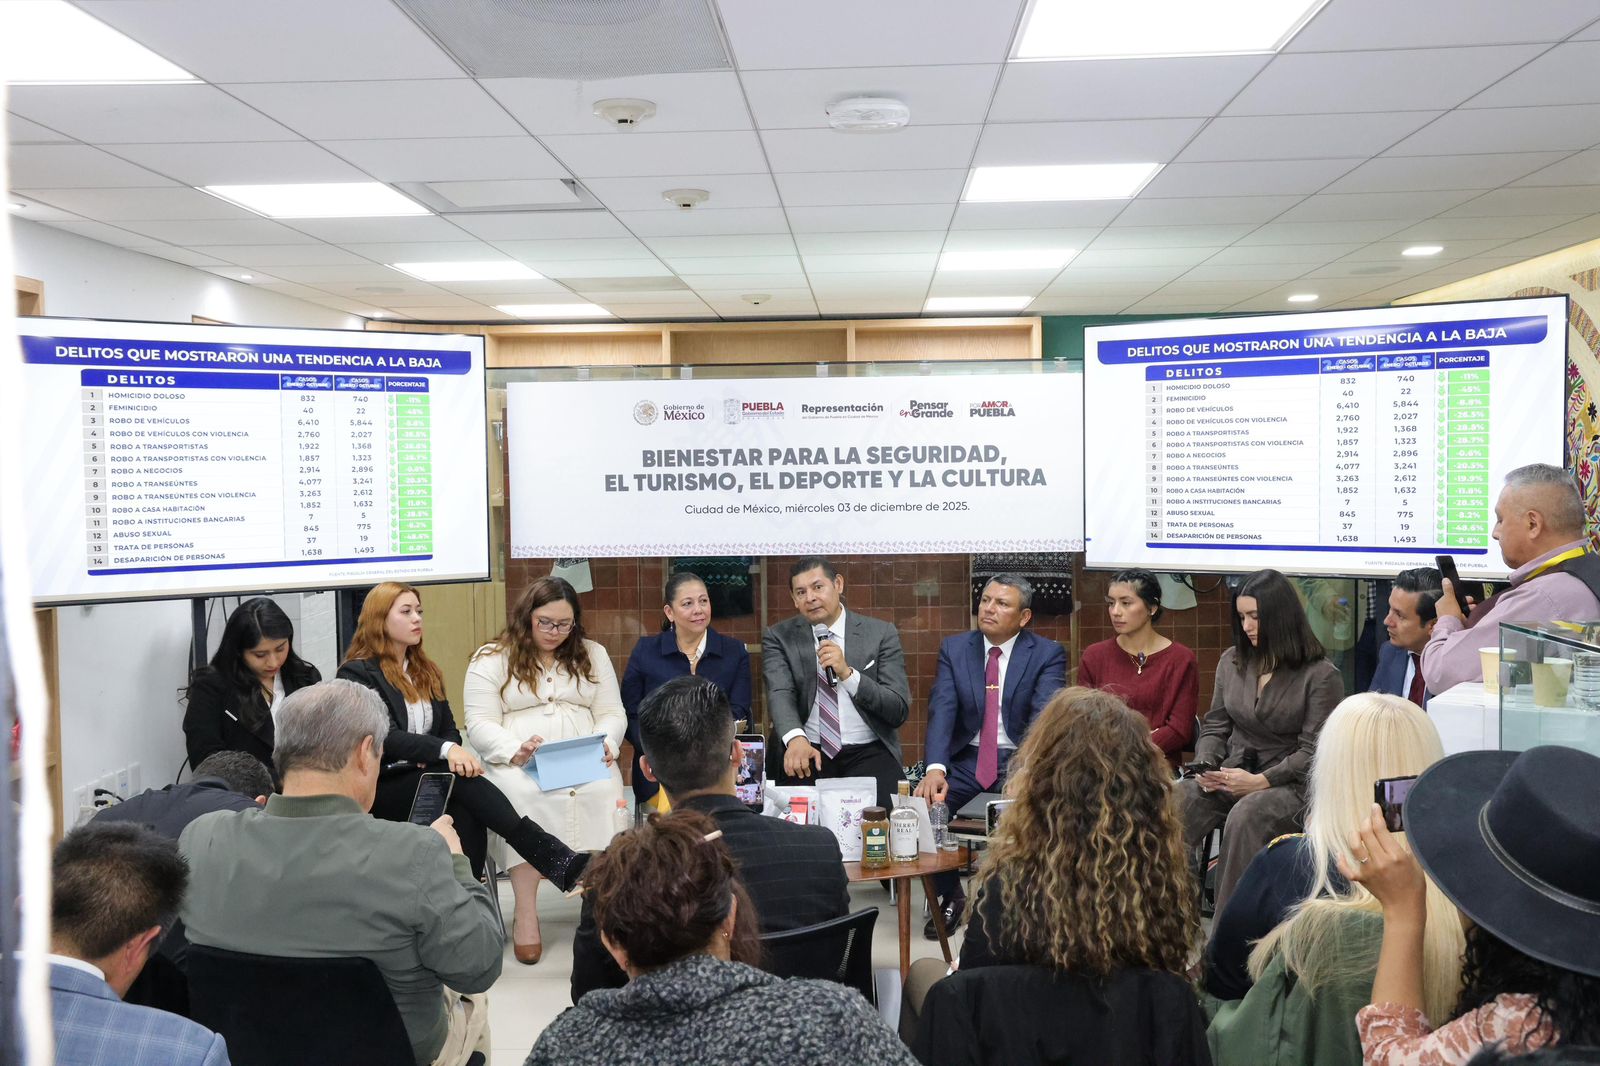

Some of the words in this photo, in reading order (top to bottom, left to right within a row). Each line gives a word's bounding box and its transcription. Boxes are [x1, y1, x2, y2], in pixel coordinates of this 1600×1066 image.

[1128, 345, 1179, 357] DELITOS
[1183, 344, 1209, 356] QUE
[1214, 339, 1299, 353] MOSTRARON
[1304, 338, 1334, 348] UNA
[1337, 331, 1422, 346] TENDENCIA
[1426, 331, 1437, 342] A
[1442, 330, 1461, 341] LA
[1465, 327, 1507, 340] BAJA
[55, 346, 123, 359] DELITOS
[127, 348, 160, 362] QUE
[165, 350, 259, 363] MOSTRARON
[263, 353, 293, 364] UNA
[297, 354, 373, 366] TENDENCIA
[376, 356, 386, 366] A
[390, 357, 406, 367] LA
[409, 357, 442, 368] BAJA
[1166, 367, 1223, 378] DELITOS
[107, 374, 176, 385] DELITOS
[1202, 382, 1231, 390] DOLOSO
[1400, 387, 1412, 395] 22
[300, 394, 316, 402] 832
[352, 395, 369, 403] 740
[1166, 394, 1206, 402] FEMINICIDIO
[742, 402, 784, 411] PUEBLA
[801, 402, 883, 415] Representación
[910, 400, 948, 410] Pensar
[1336, 401, 1360, 410] 6,410
[1393, 400, 1419, 408] 5,844
[664, 410, 705, 420] México
[900, 410, 912, 419] en
[911, 409, 954, 418] Grande
[970, 407, 1015, 417] PUEBLA
[1393, 412, 1418, 421] 2,027
[1336, 414, 1360, 422] 2,760
[1337, 426, 1359, 434] 1,922
[1394, 425, 1417, 433] 1,368
[1336, 438, 1359, 446] 1,857
[1394, 437, 1417, 446] 1,323
[642, 447, 763, 468] BIENESTAR
[768, 447, 829, 466] PARA
[834, 446, 861, 465] LA
[866, 444, 1007, 465] SEGURIDAD,
[1336, 450, 1359, 458] 2,914
[1393, 449, 1419, 458] 2,896
[1335, 462, 1360, 471] 4,077
[1394, 462, 1417, 470] 3,241
[605, 474, 629, 493] EL
[633, 472, 744, 495] TURISMO,
[749, 471, 774, 490] EL
[779, 470, 883, 490] DEPORTE
[888, 470, 903, 488] Y
[909, 469, 937, 488] LA
[941, 468, 1047, 488] CULTURA
[1336, 474, 1360, 483] 3,263
[1394, 474, 1417, 482] 2,612
[1336, 486, 1359, 494] 1,852
[1394, 486, 1417, 495] 1,632
[144, 492, 198, 500] TRANSEÚNTES
[1402, 498, 1408, 506] 5
[684, 504, 724, 515] Ciudad
[726, 504, 740, 514] de
[743, 504, 782, 514] México,
[785, 503, 835, 513] miércoles
[837, 502, 851, 513] 03
[853, 502, 867, 513] de
[870, 502, 923, 512] diciembre
[925, 502, 940, 512] de
[942, 501, 970, 511] 2025.
[144, 517, 202, 525] INSTITUCIONES
[203, 516, 246, 524] BANCARIAS
[1342, 522, 1353, 530] 37
[1400, 523, 1410, 531] 19
[142, 530, 172, 538] SEXUAL
[1336, 535, 1359, 543] 1,638
[1393, 535, 1417, 544] 1,493
[153, 542, 194, 550] PERSONAS
[354, 546, 375, 554] 1,493
[301, 548, 323, 557] 1,638
[113, 555, 172, 564] DESAPARICIÓN
[186, 552, 226, 561] PERSONAS
